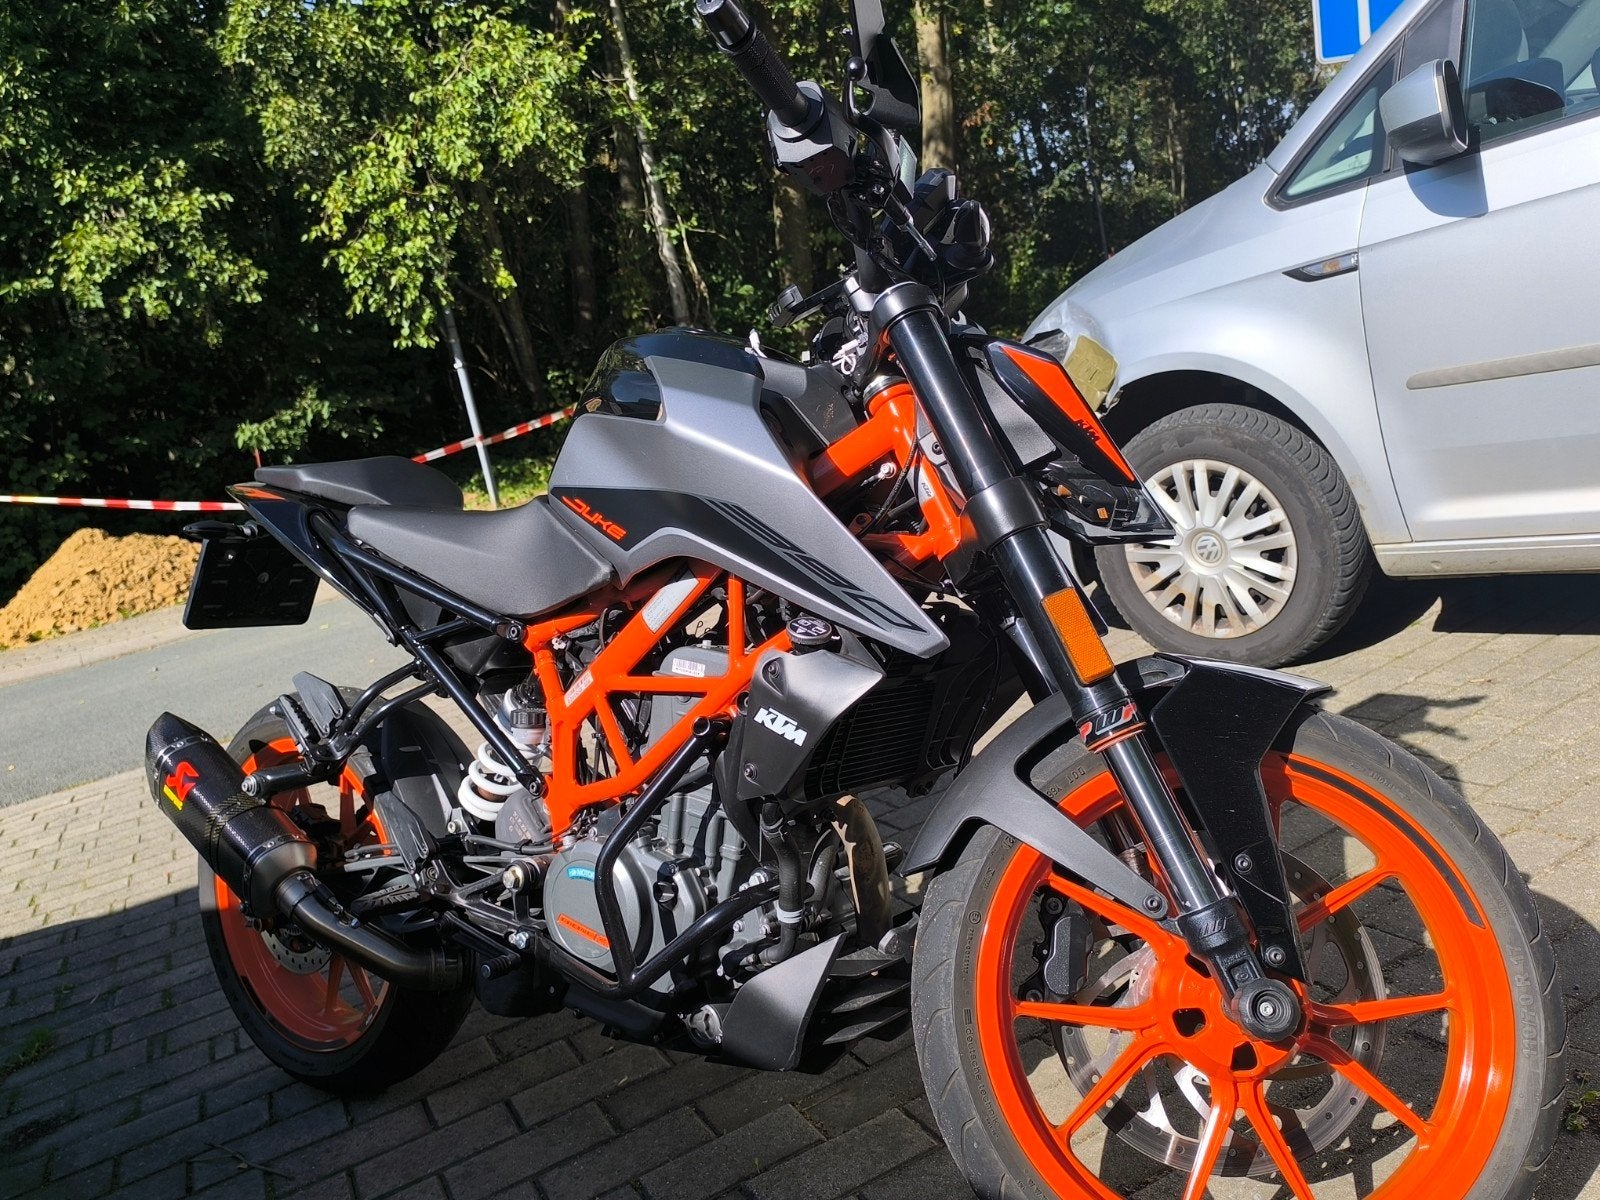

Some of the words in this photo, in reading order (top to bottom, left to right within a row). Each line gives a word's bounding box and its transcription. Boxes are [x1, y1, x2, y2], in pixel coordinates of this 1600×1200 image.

[1077, 418, 1102, 442] KTM
[561, 496, 628, 541] DUKE
[753, 707, 808, 747] KTM
[965, 1028, 982, 1081] deutsche
[978, 1083, 1001, 1126] technik
